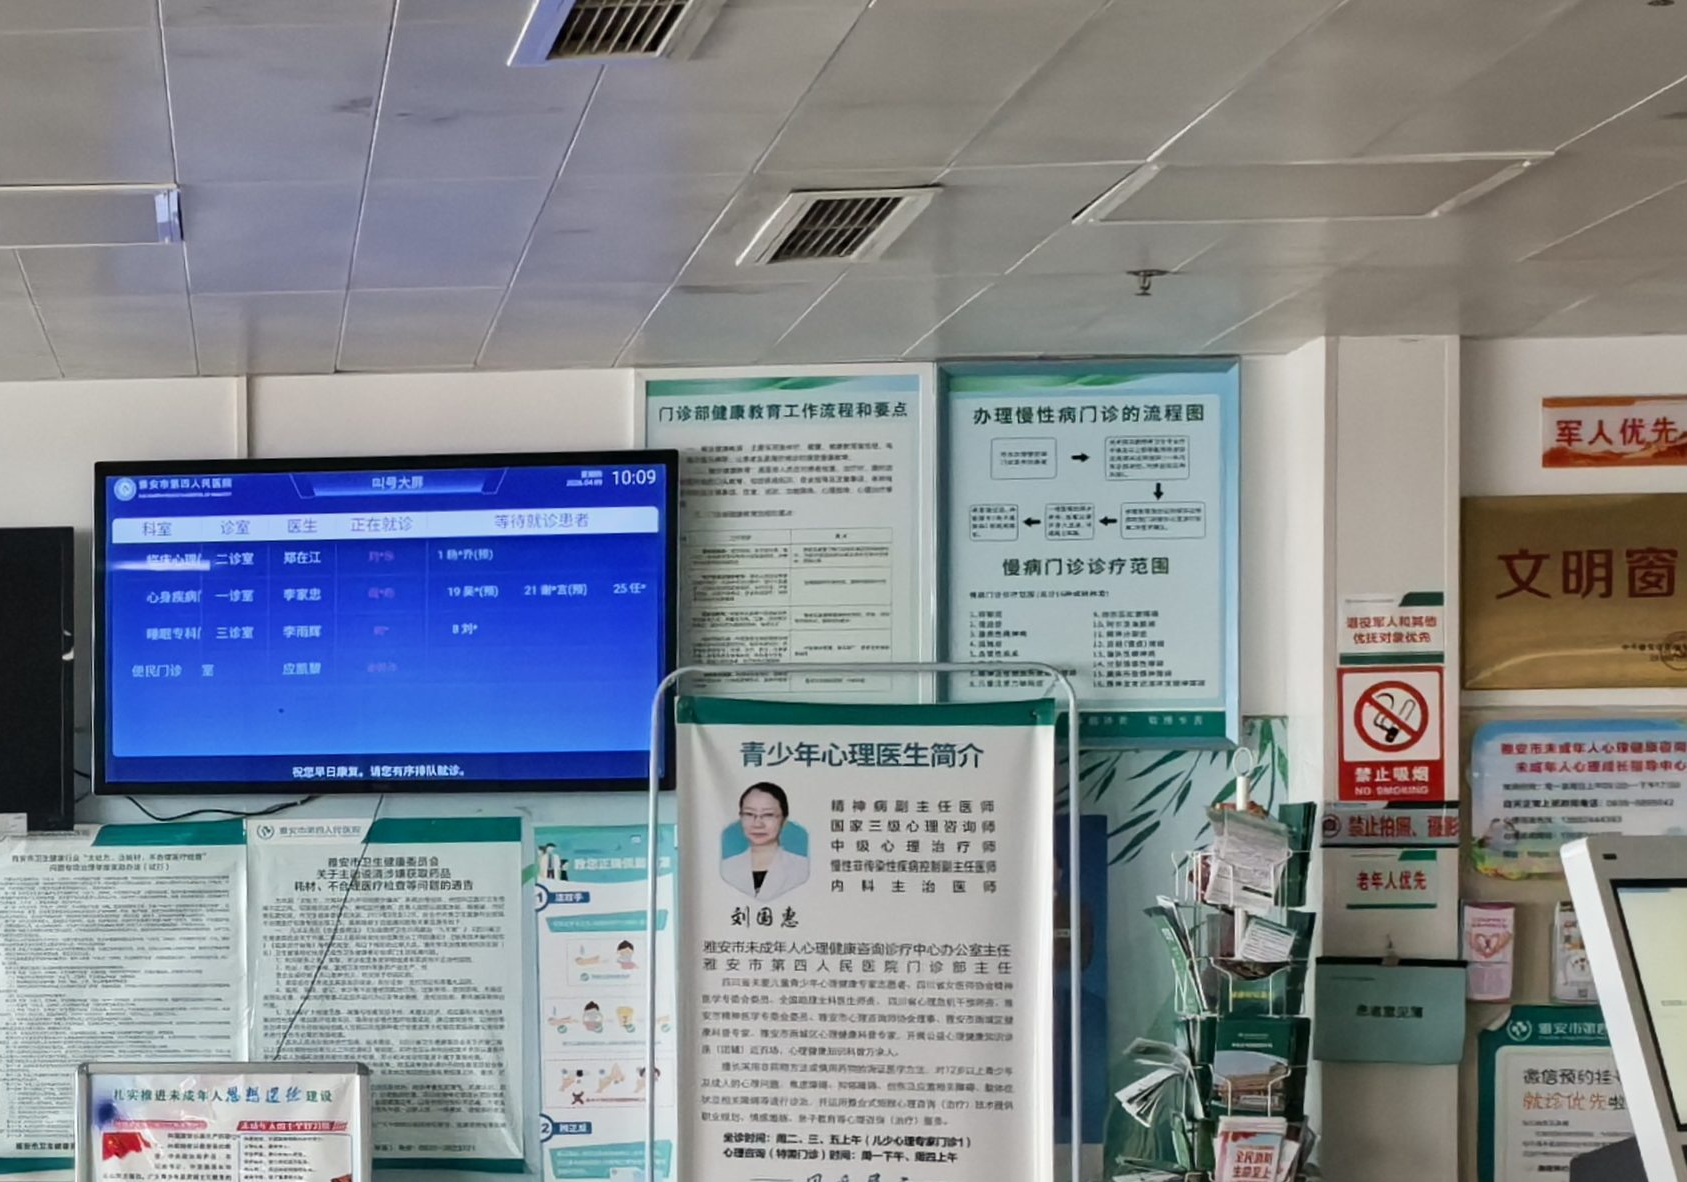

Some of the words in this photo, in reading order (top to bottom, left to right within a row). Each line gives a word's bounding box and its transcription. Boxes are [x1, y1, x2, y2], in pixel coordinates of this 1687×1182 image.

[658, 401, 908, 422] 门诊部健康教育工作流程和要点
[973, 404, 1205, 425] 办理慢性病门诊的流程图
[1556, 417, 1677, 447] 军人优先
[372, 475, 424, 490] 叫号大屏
[612, 469, 656, 485] 10:09
[142, 521, 172, 537] 科室
[220, 520, 250, 535] 诊室
[287, 519, 318, 533] 医生
[351, 516, 413, 532] 正在就诊
[494, 513, 589, 529] 等待就诊患者
[215, 553, 255, 565] 二诊室
[1002, 557, 1170, 577] 慢病门诊诊疗范围
[1496, 547, 1678, 600] 文明窗
[215, 590, 255, 603] 一诊室
[215, 626, 255, 639] 三诊室
[131, 664, 182, 678] 便民门诊
[740, 741, 984, 769] 青少年心理医生简介
[1355, 767, 1429, 782] 禁止吸烟
[1355, 787, 1371, 796] NO
[831, 799, 995, 813] 精神病副主任医师
[831, 819, 995, 834] 国家三级心理咨询师
[831, 839, 996, 853] 中级心理治疗师
[831, 879, 997, 894] 内科主治医师
[1357, 871, 1427, 890] 老年人优先
[730, 906, 800, 928] 刘国惠
[703, 941, 1011, 957] 雅安市未成年人心理健康咨询诊疗中心办公室主任
[702, 959, 1012, 974] 雅安市第四人民医院门诊部主任
